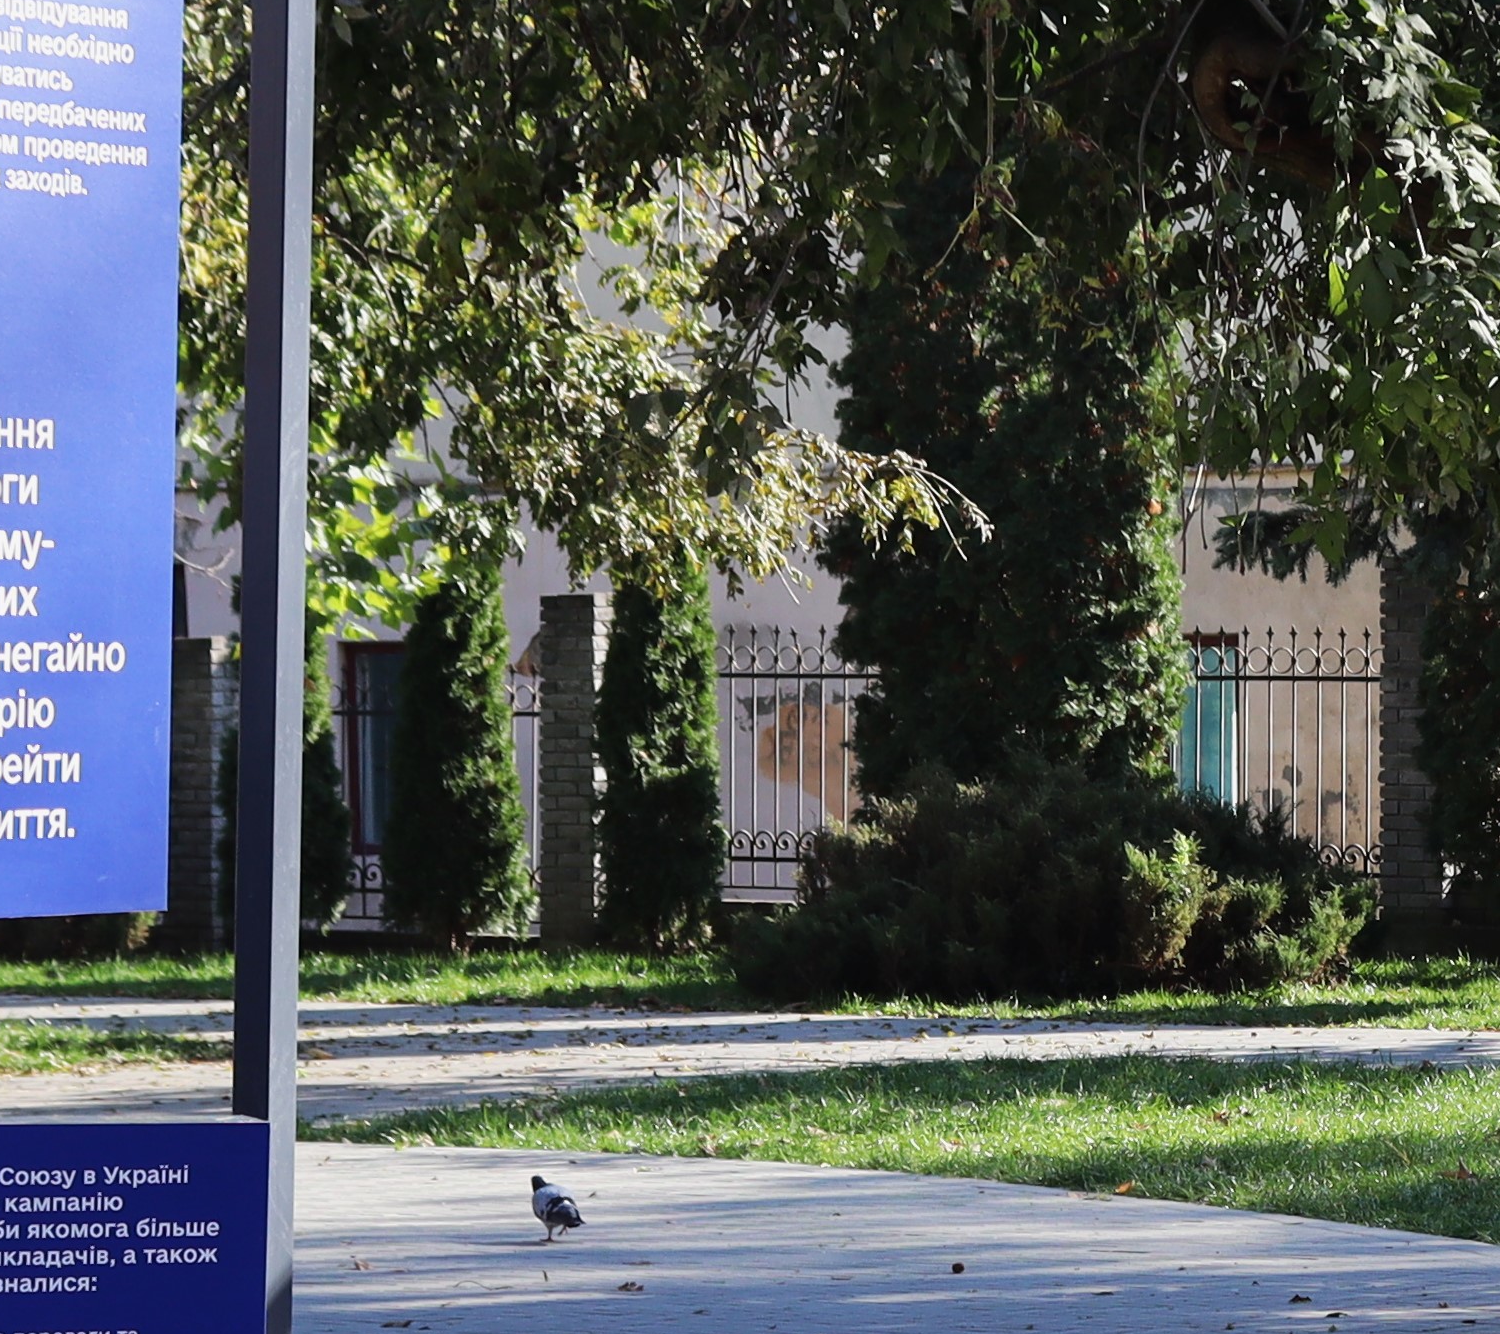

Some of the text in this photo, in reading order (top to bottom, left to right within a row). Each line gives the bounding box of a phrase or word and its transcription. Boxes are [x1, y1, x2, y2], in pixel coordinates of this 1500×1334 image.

[4, 167, 88, 198] заходів.
[83, 1169, 97, 1185] в
[102, 1164, 189, 1189] Україні
[26, 1222, 130, 1240] якомога
[135, 1217, 220, 1238] більше
